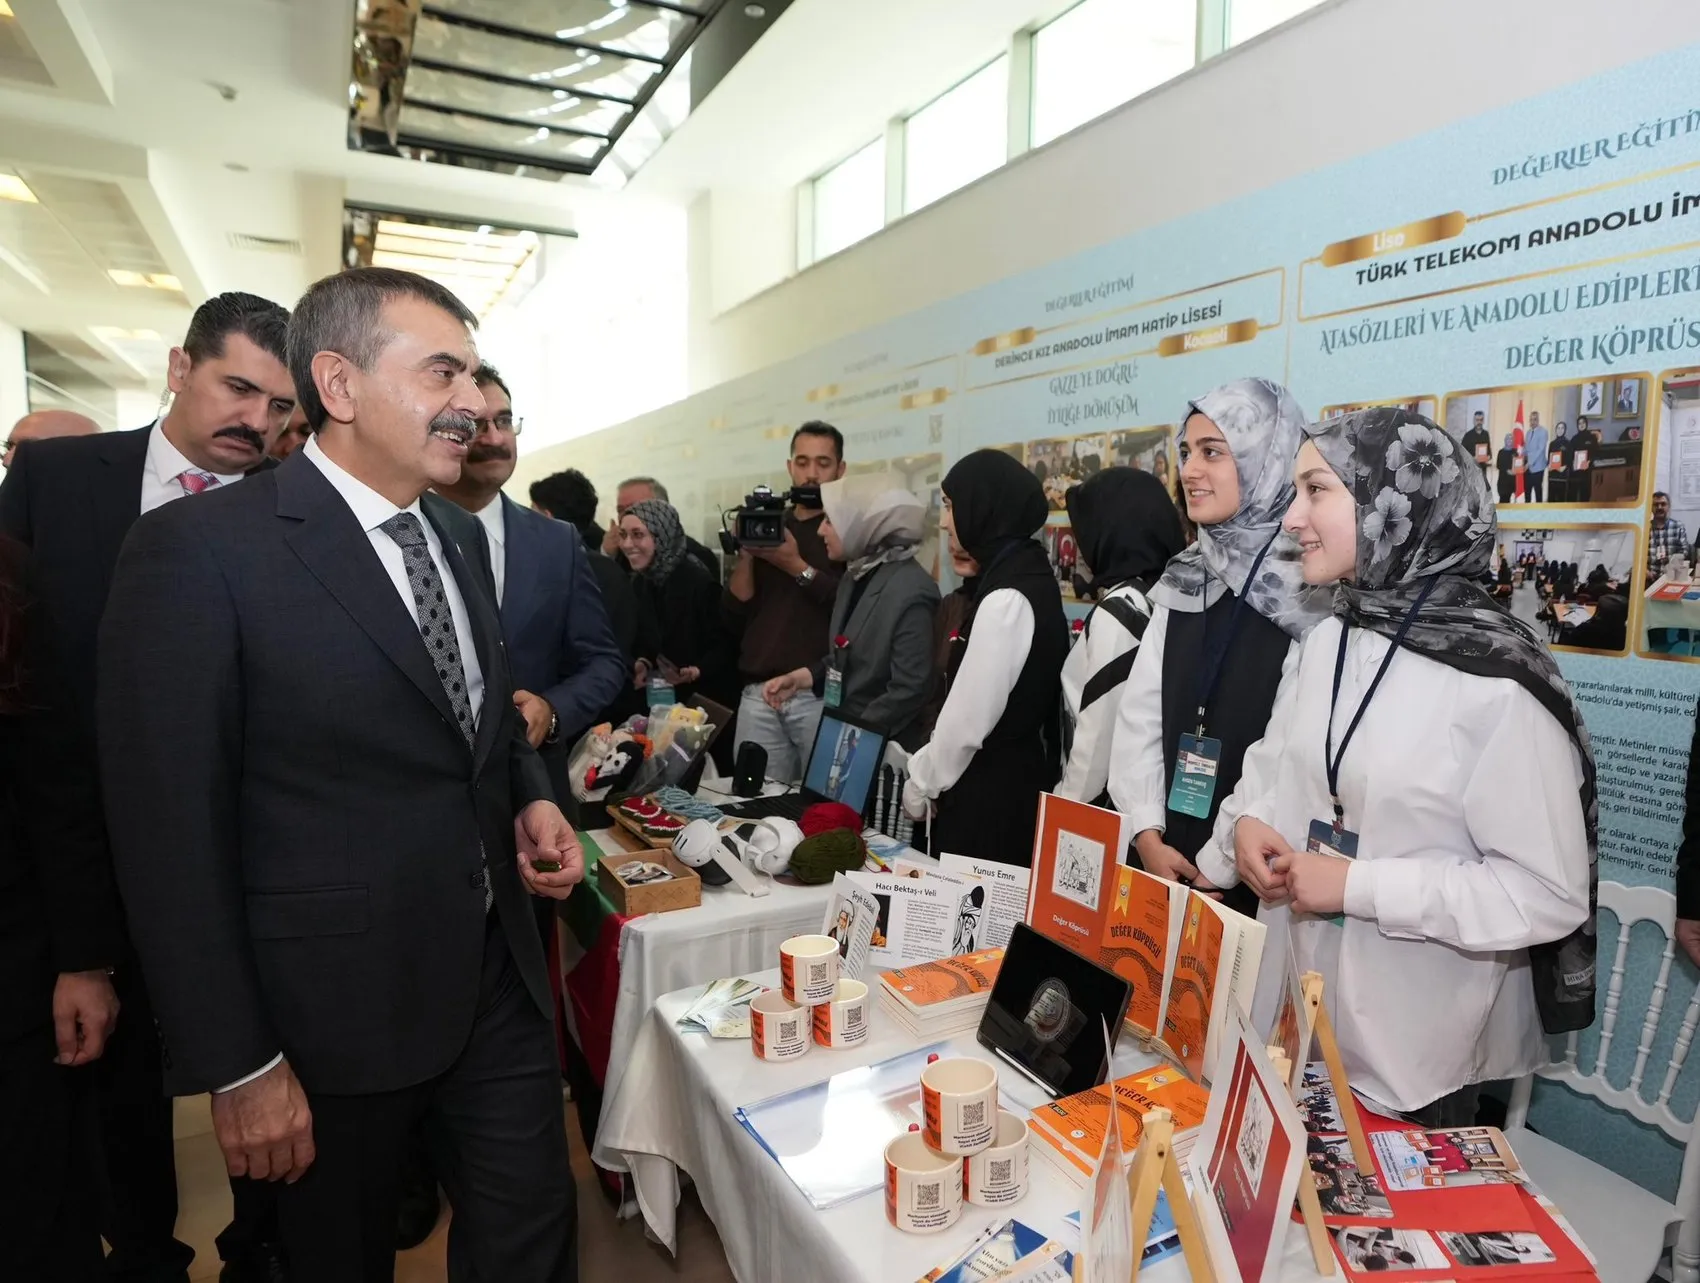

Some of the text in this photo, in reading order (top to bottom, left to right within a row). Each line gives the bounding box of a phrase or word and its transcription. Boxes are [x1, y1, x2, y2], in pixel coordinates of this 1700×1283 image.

[1493, 137, 1617, 186] DEĞERLER
[1356, 259, 1408, 286] TÜRK
[1413, 233, 1521, 273] TELEKOM
[1528, 201, 1663, 248] ANADOLU
[1320, 308, 1426, 355] ATASÖZLERİ
[1430, 308, 1457, 332] VE
[1459, 287, 1570, 333] ANADOLU
[994, 299, 1222, 368] DERİNCE KIZ ANADOLU İMAM HATİP LİSESİ
[1505, 336, 1585, 370] DEĞER
[1575, 692, 1624, 707] Anadolu'da
[1624, 700, 1662, 715] yetişmiş
[1659, 689, 1696, 703] kültürel
[1618, 737, 1657, 752] Metinler
[1607, 750, 1658, 766] görsellerde
[1616, 765, 1637, 777] edip
[1639, 769, 1651, 777] ve
[1629, 794, 1662, 808] esasına
[1613, 804, 1631, 814] geri
[1632, 806, 1681, 825] bildirimler
[1609, 829, 1637, 842] olarak
[1640, 836, 1669, 850] ortaya
[1620, 843, 1645, 856] Farklı
[972, 865, 1016, 882] Yunus Emre
[1647, 863, 1667, 876] Geri
[875, 882, 937, 898] Hacı Bektaş-ı Veli
[1110, 922, 1162, 958] DEĞER KÖPRÜSÜ
